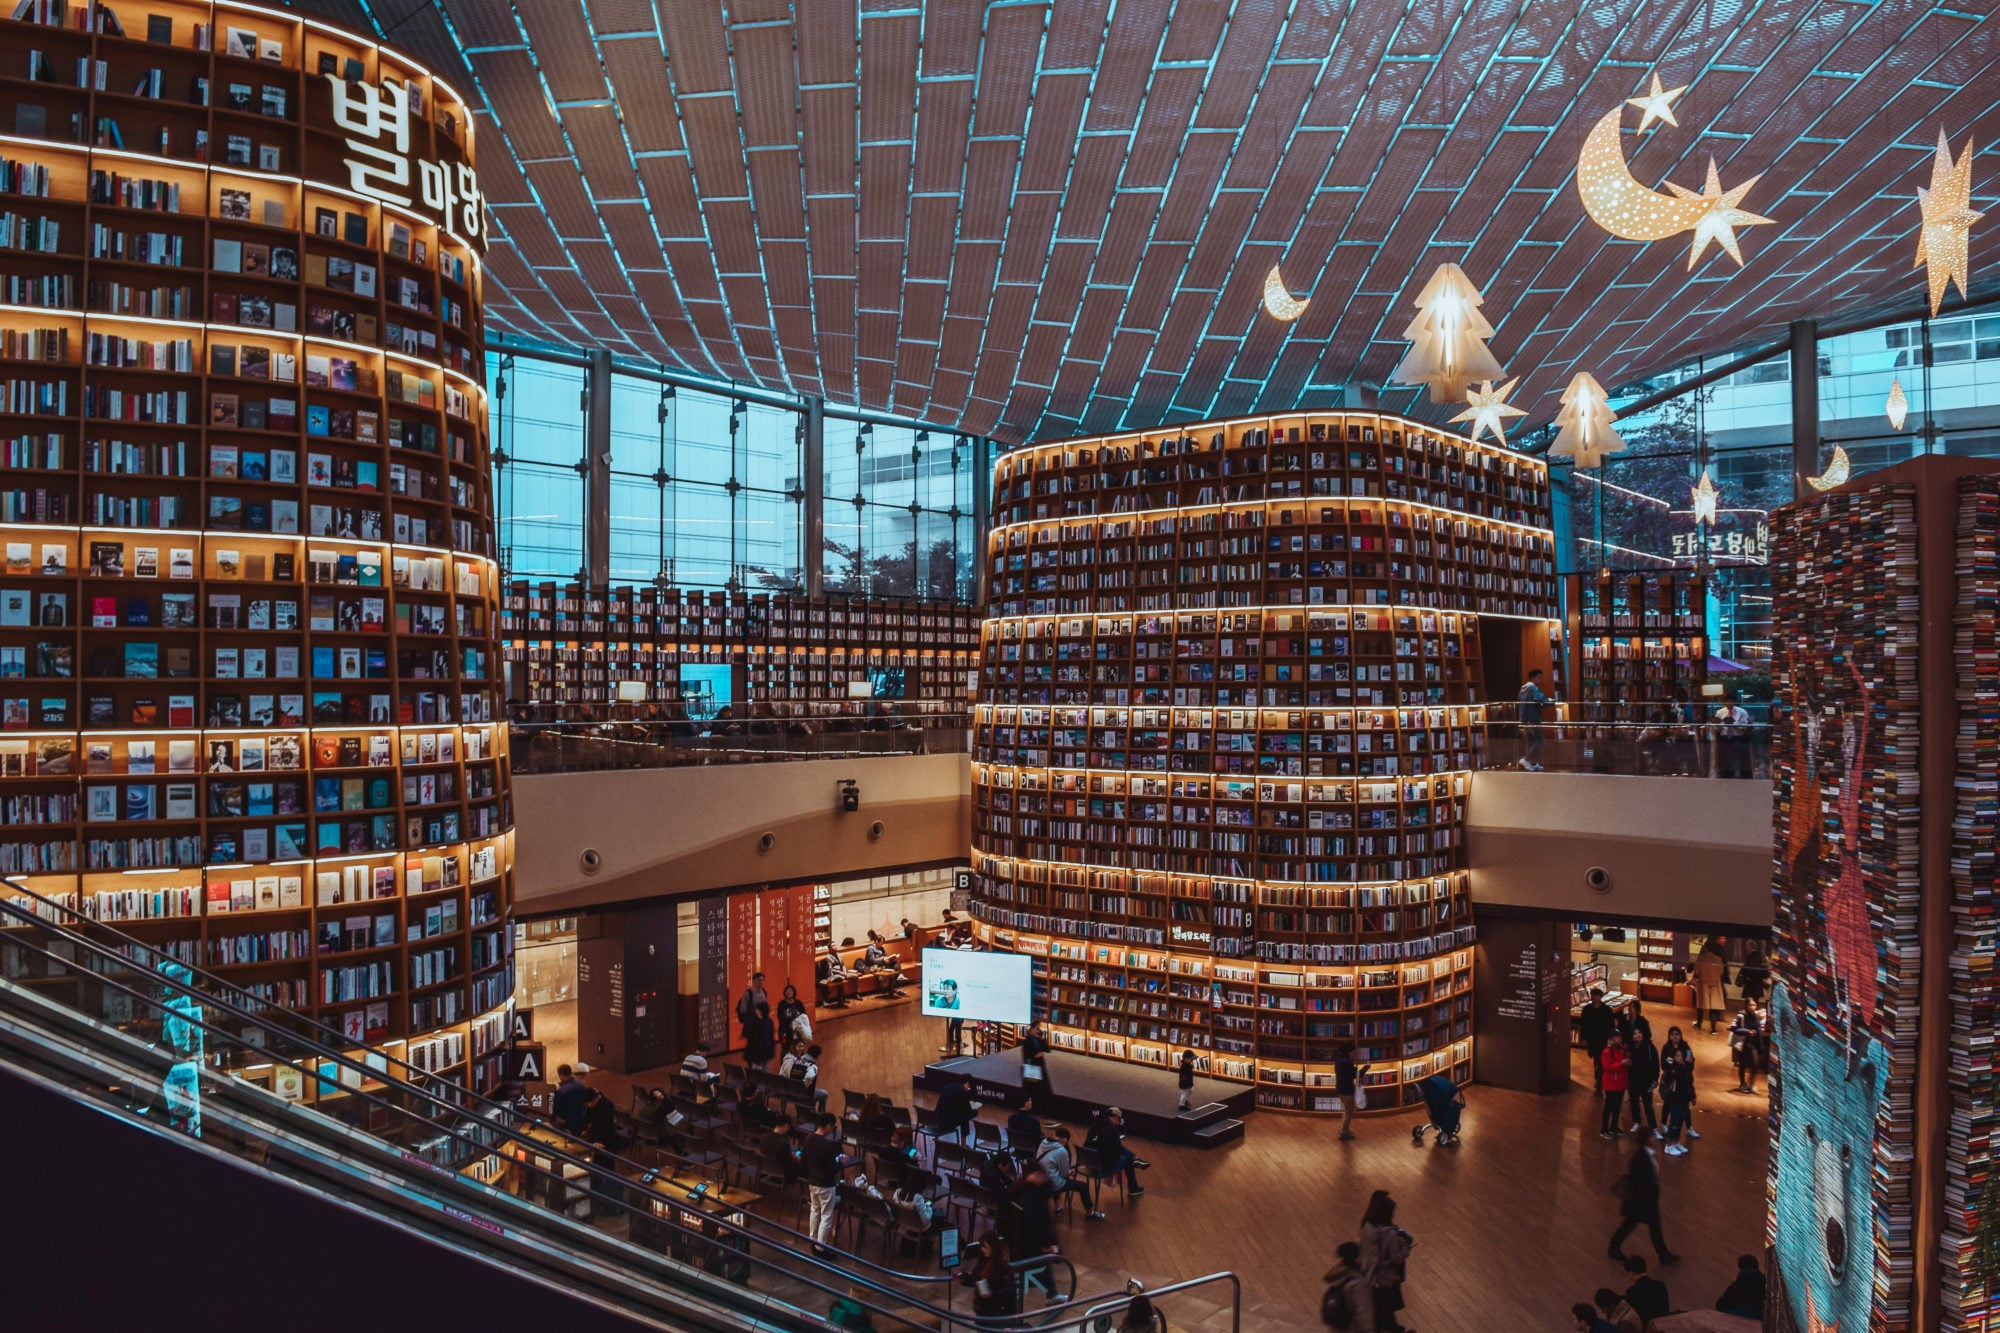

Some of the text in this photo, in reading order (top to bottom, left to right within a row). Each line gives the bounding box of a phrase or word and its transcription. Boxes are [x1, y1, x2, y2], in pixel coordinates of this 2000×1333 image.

[324, 73, 489, 252] 별마당
[959, 874, 969, 888] B
[1245, 912, 1252, 928] B
[515, 1015, 528, 1037] A
[518, 1053, 540, 1077] A
[516, 1094, 542, 1107] 소설
